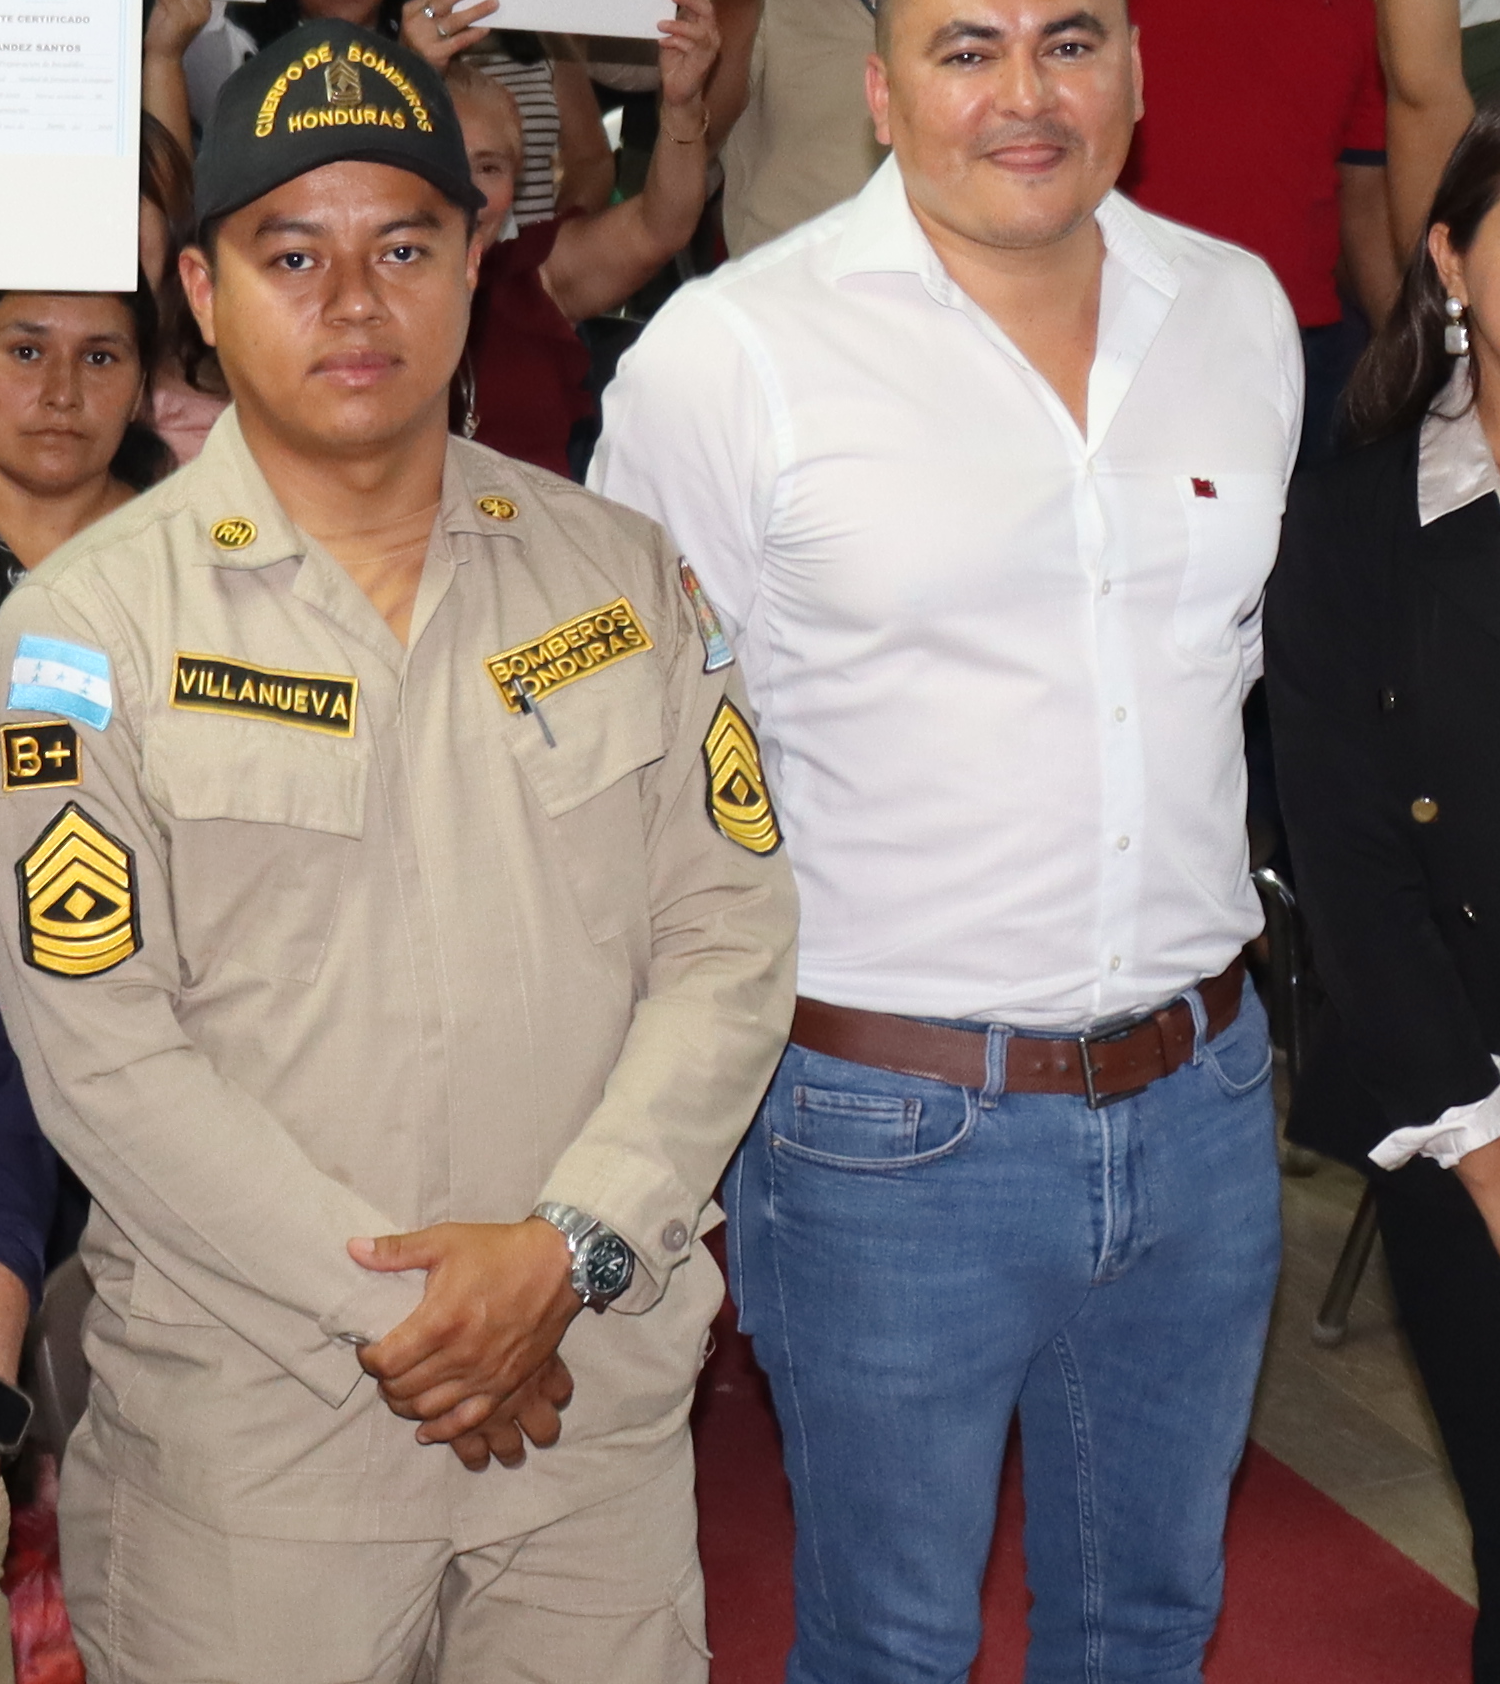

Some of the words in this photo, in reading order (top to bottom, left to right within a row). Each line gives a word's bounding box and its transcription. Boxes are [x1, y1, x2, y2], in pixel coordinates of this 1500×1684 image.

[17, 14, 91, 25] CERTIFICADO
[35, 43, 82, 53] SANTOS
[255, 60, 303, 138] CUERPO
[303, 42, 333, 70] DE
[347, 42, 434, 133] BOMBEROS
[288, 106, 406, 134] HONDURAS
[217, 522, 252, 544] RH
[491, 607, 631, 683] BOMBEROS
[179, 666, 349, 720] VILLANUEVA
[10, 735, 71, 778] B+
